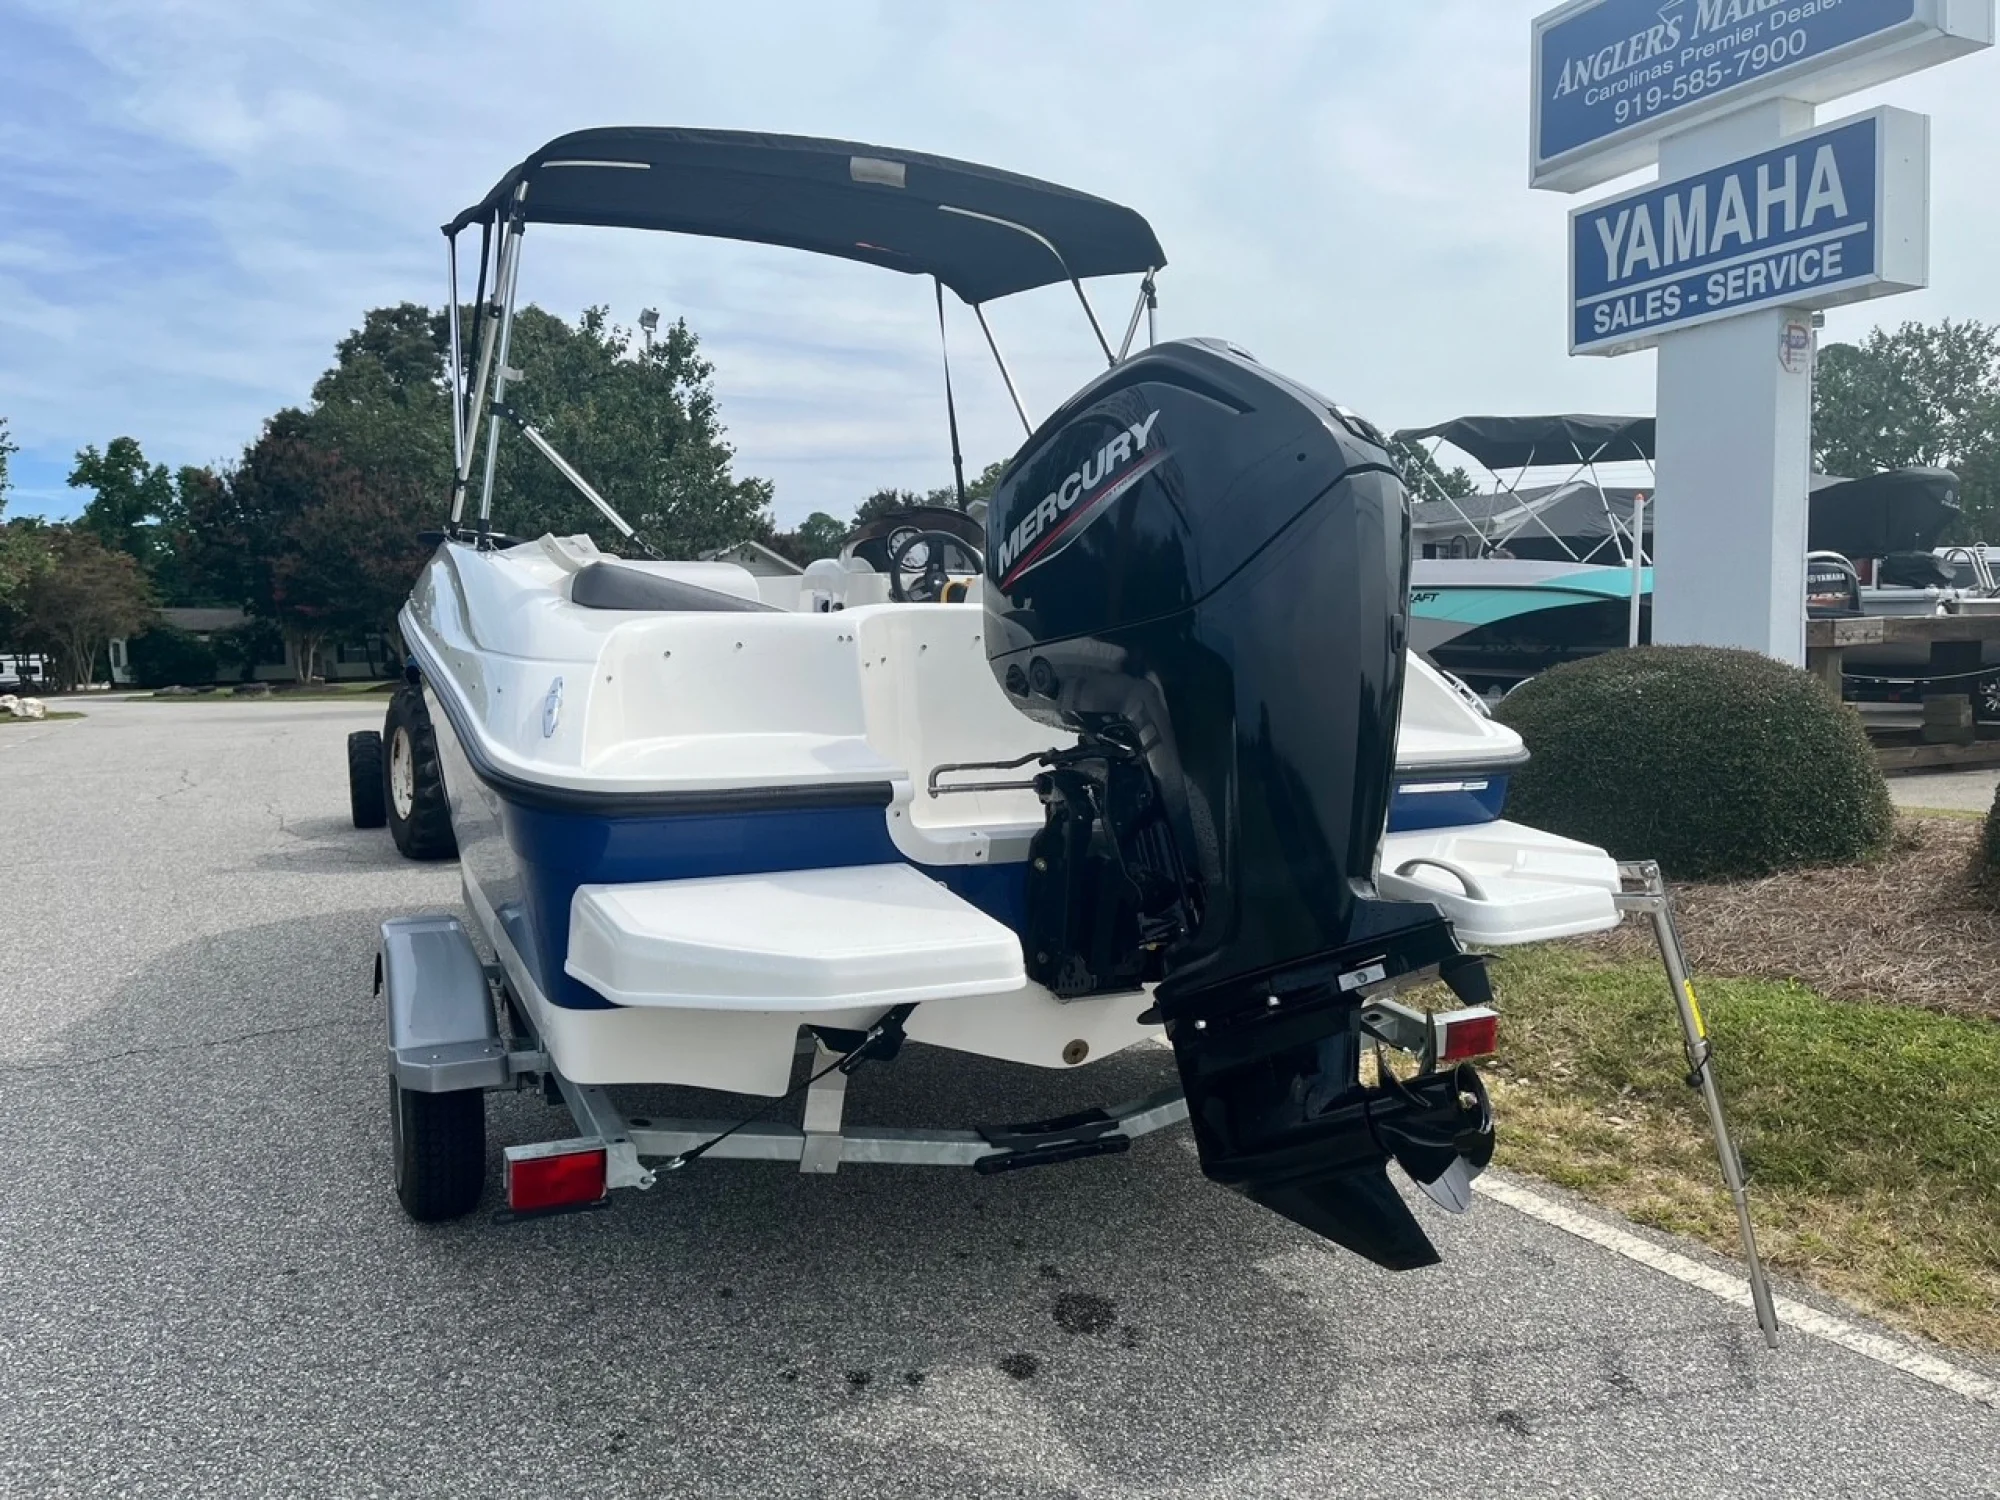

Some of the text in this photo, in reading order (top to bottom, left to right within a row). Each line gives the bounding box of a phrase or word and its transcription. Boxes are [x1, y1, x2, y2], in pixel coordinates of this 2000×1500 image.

[1585, 0, 1842, 105] Carolinas Premier Deale
[1614, 29, 1807, 123] 919-585-7900
[1595, 144, 1849, 282] YAMAHA
[1594, 285, 1681, 334] SALES
[1706, 241, 1843, 305] SERVICE
[998, 409, 1161, 577] MERCURY
